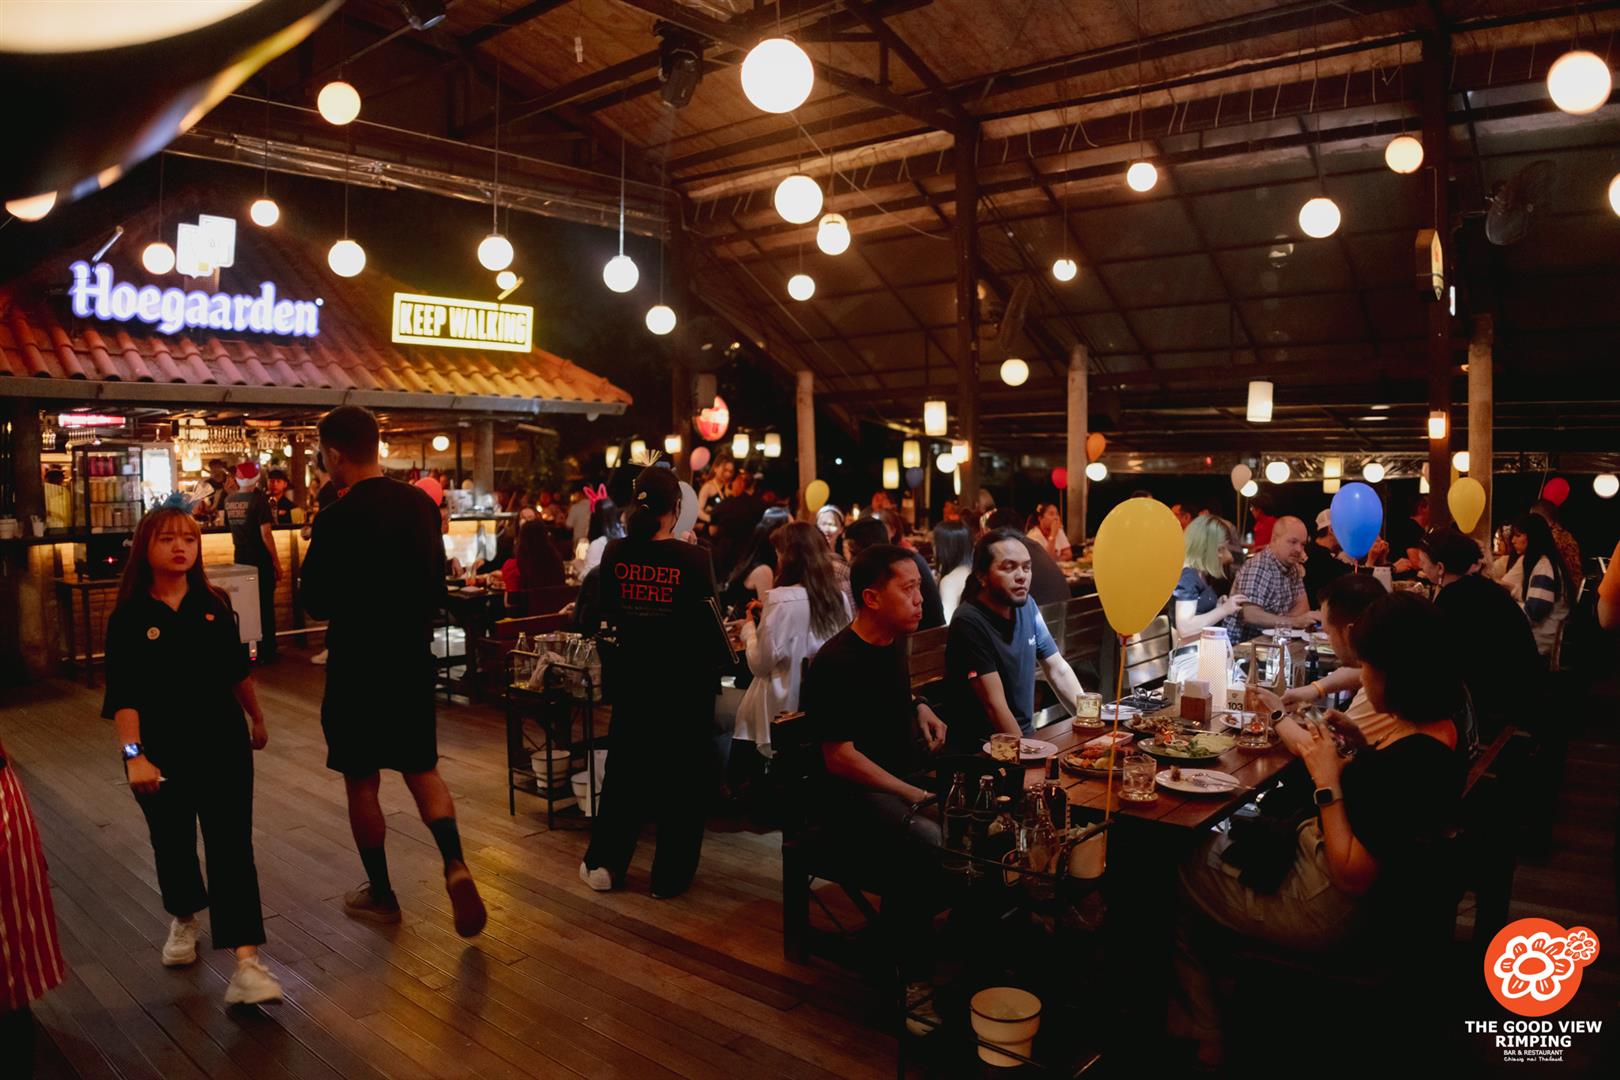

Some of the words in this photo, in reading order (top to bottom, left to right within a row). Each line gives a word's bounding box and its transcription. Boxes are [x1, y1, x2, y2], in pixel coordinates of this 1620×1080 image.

[69, 261, 319, 336] Hoegaarden
[400, 302, 447, 337] KEEP
[449, 306, 527, 344] WALKING
[614, 561, 681, 585] ORDER
[621, 583, 673, 603] HERE
[1228, 702, 1243, 711] 103
